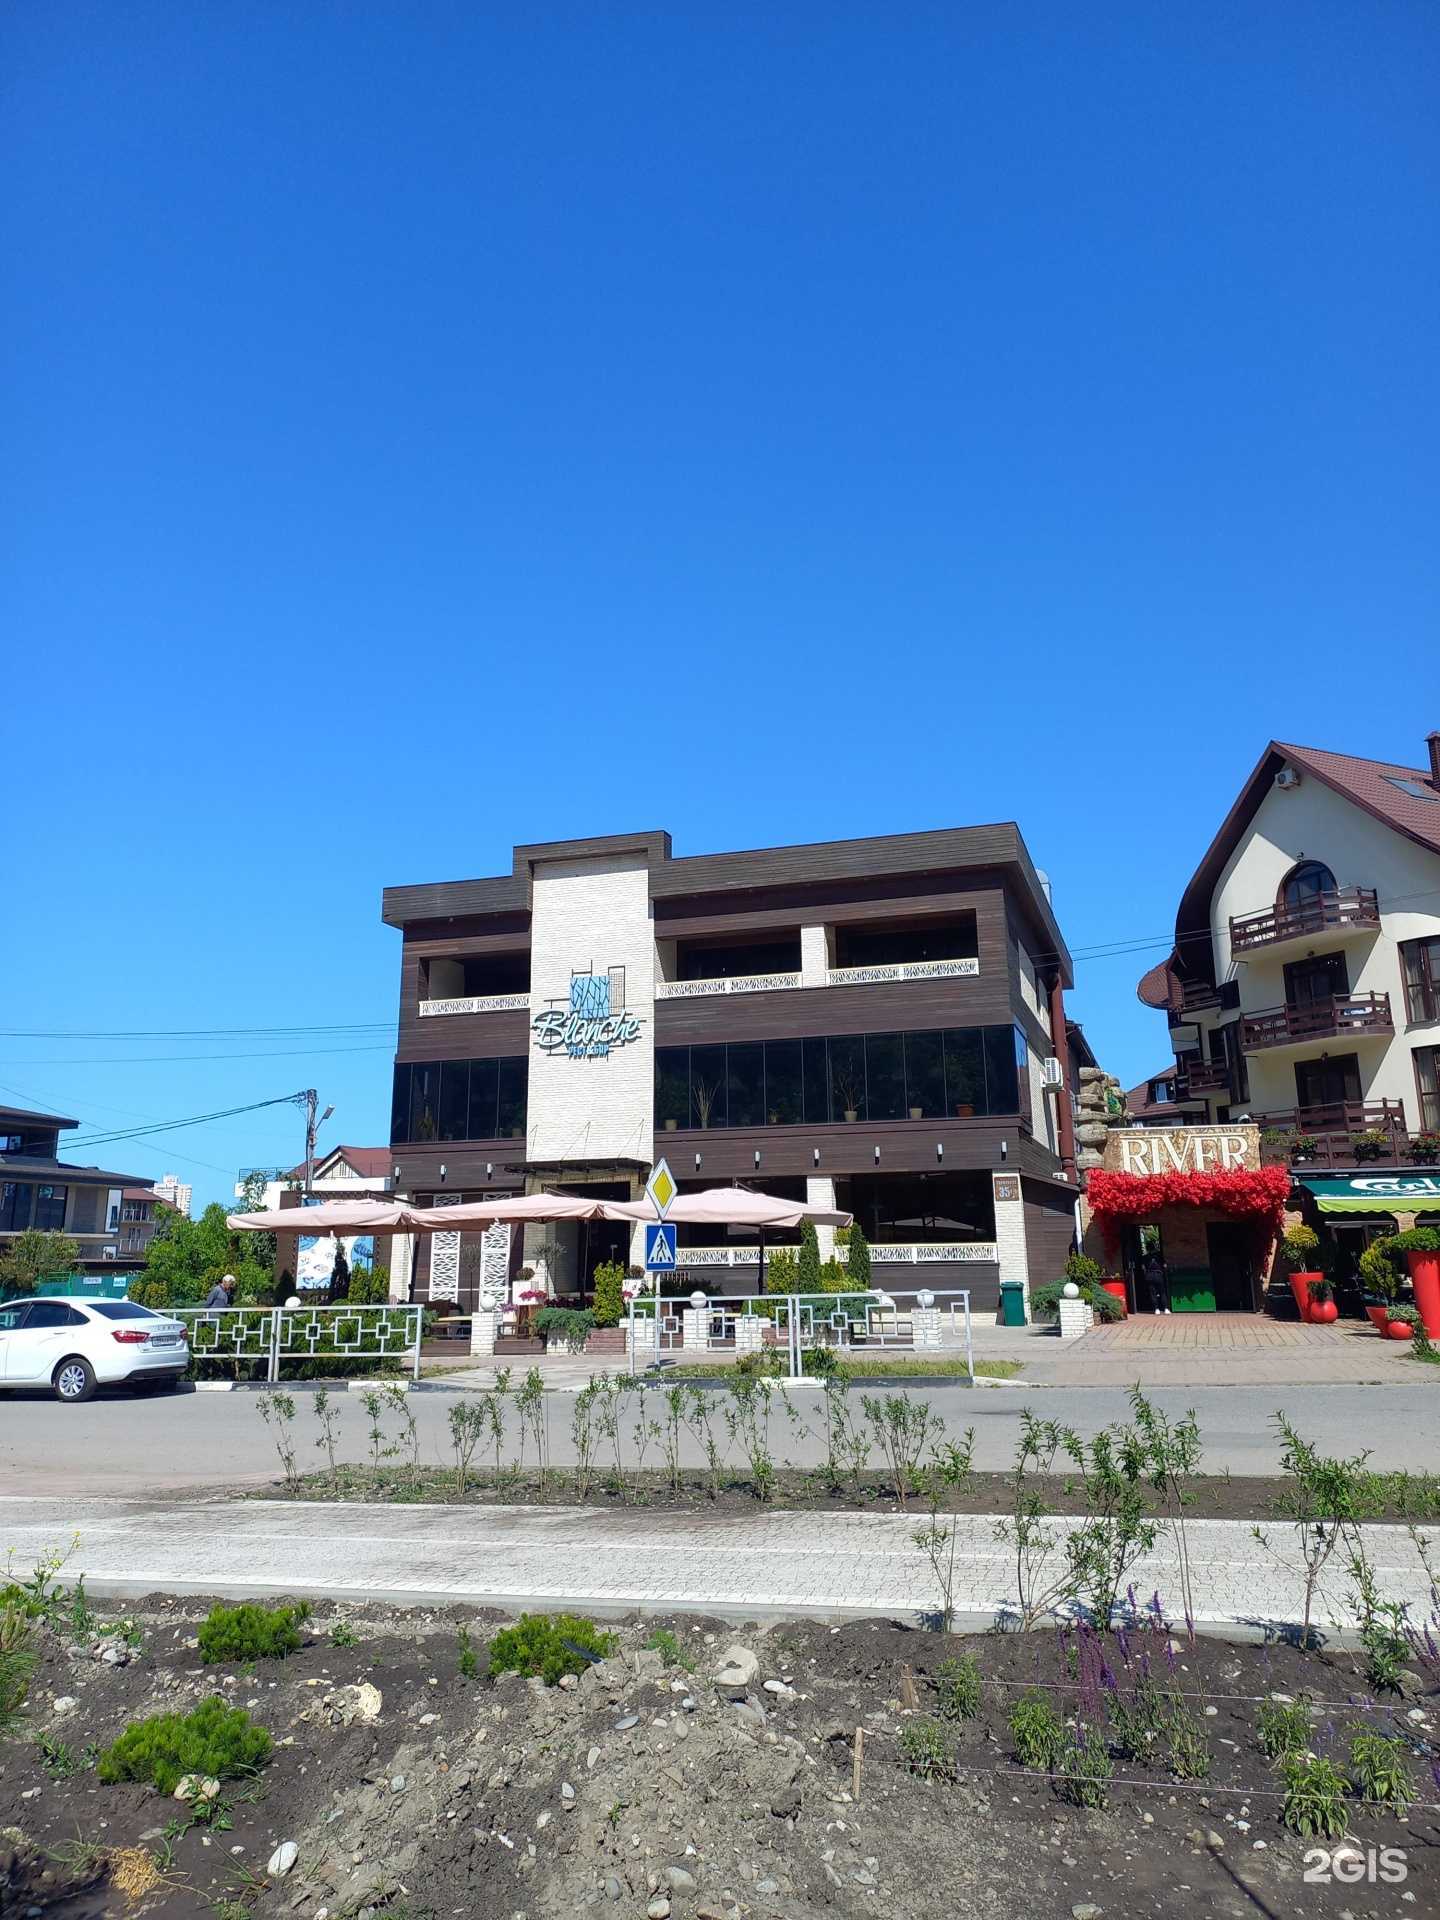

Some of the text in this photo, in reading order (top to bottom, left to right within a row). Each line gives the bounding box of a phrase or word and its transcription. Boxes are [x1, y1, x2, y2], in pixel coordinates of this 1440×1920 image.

[534, 1009, 640, 1046] Blanche
[1119, 1133, 1248, 1175] RIVER
[1350, 1178, 1440, 1193] Carl
